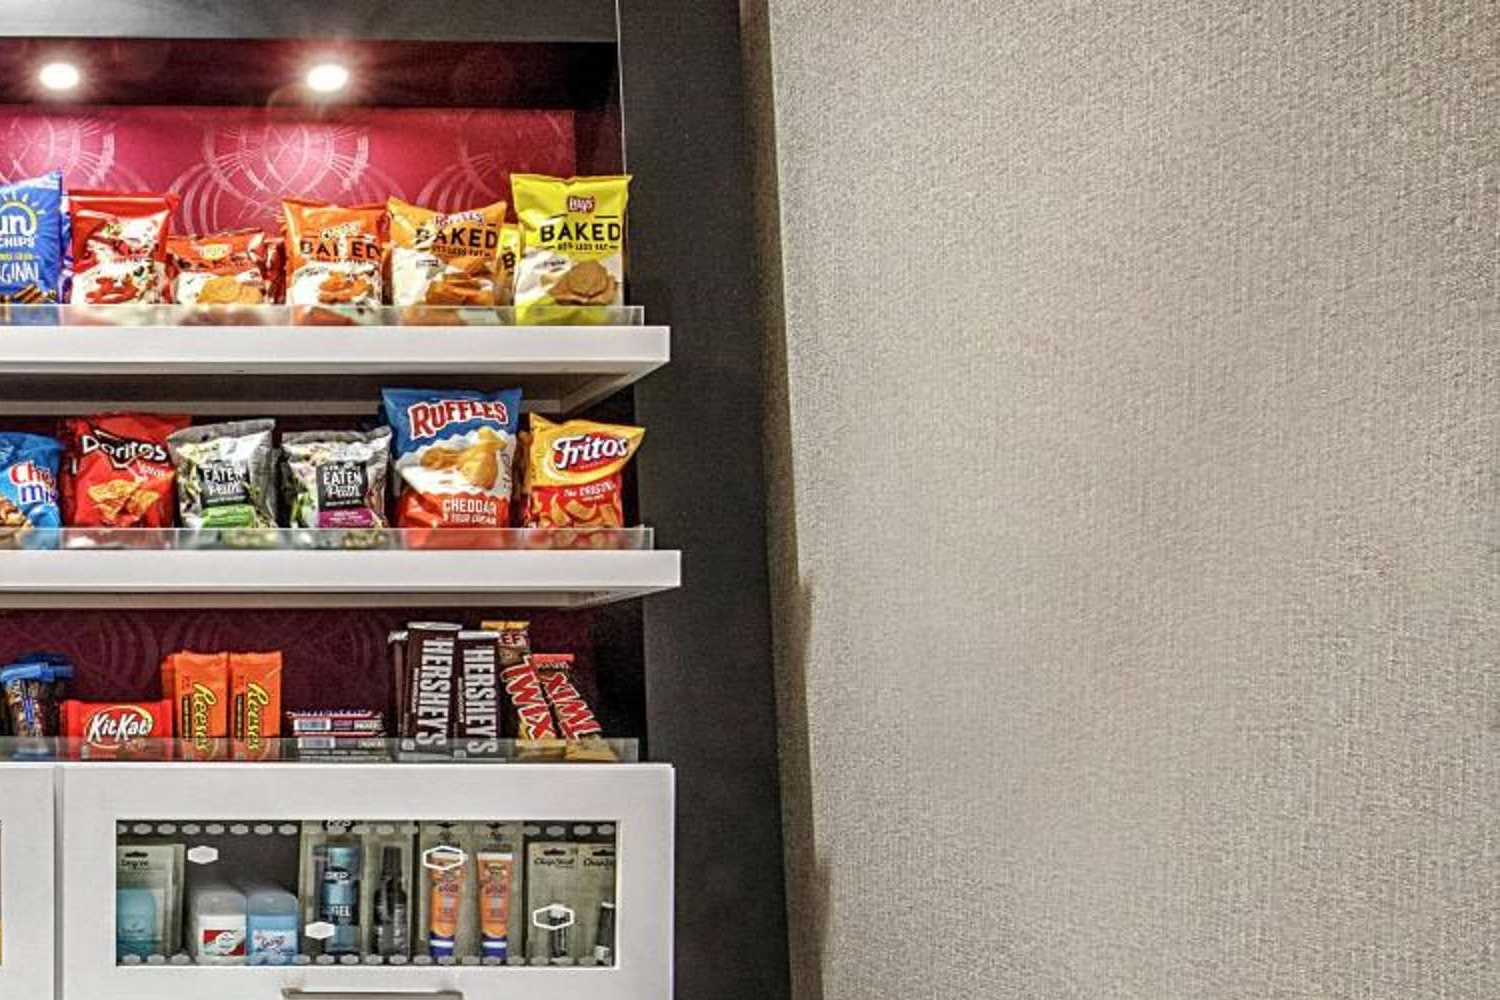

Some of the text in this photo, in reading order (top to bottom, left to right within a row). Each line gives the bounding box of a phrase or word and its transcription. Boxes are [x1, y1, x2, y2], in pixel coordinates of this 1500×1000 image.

[299, 240, 383, 260] BAED
[415, 226, 499, 249] BAKED
[539, 222, 622, 243] BAKED
[410, 401, 508, 440] RUFFLES
[82, 433, 168, 462] Doritos
[552, 433, 628, 471] Fritos
[323, 471, 363, 485] EATEN
[443, 498, 497, 516] CHEDDAR
[415, 638, 455, 747] HERSHEY'S
[462, 647, 498, 754] HERSHEY'S
[500, 655, 558, 741] TWIX
[193, 682, 217, 752] Reese's
[247, 682, 270, 752] Reese's
